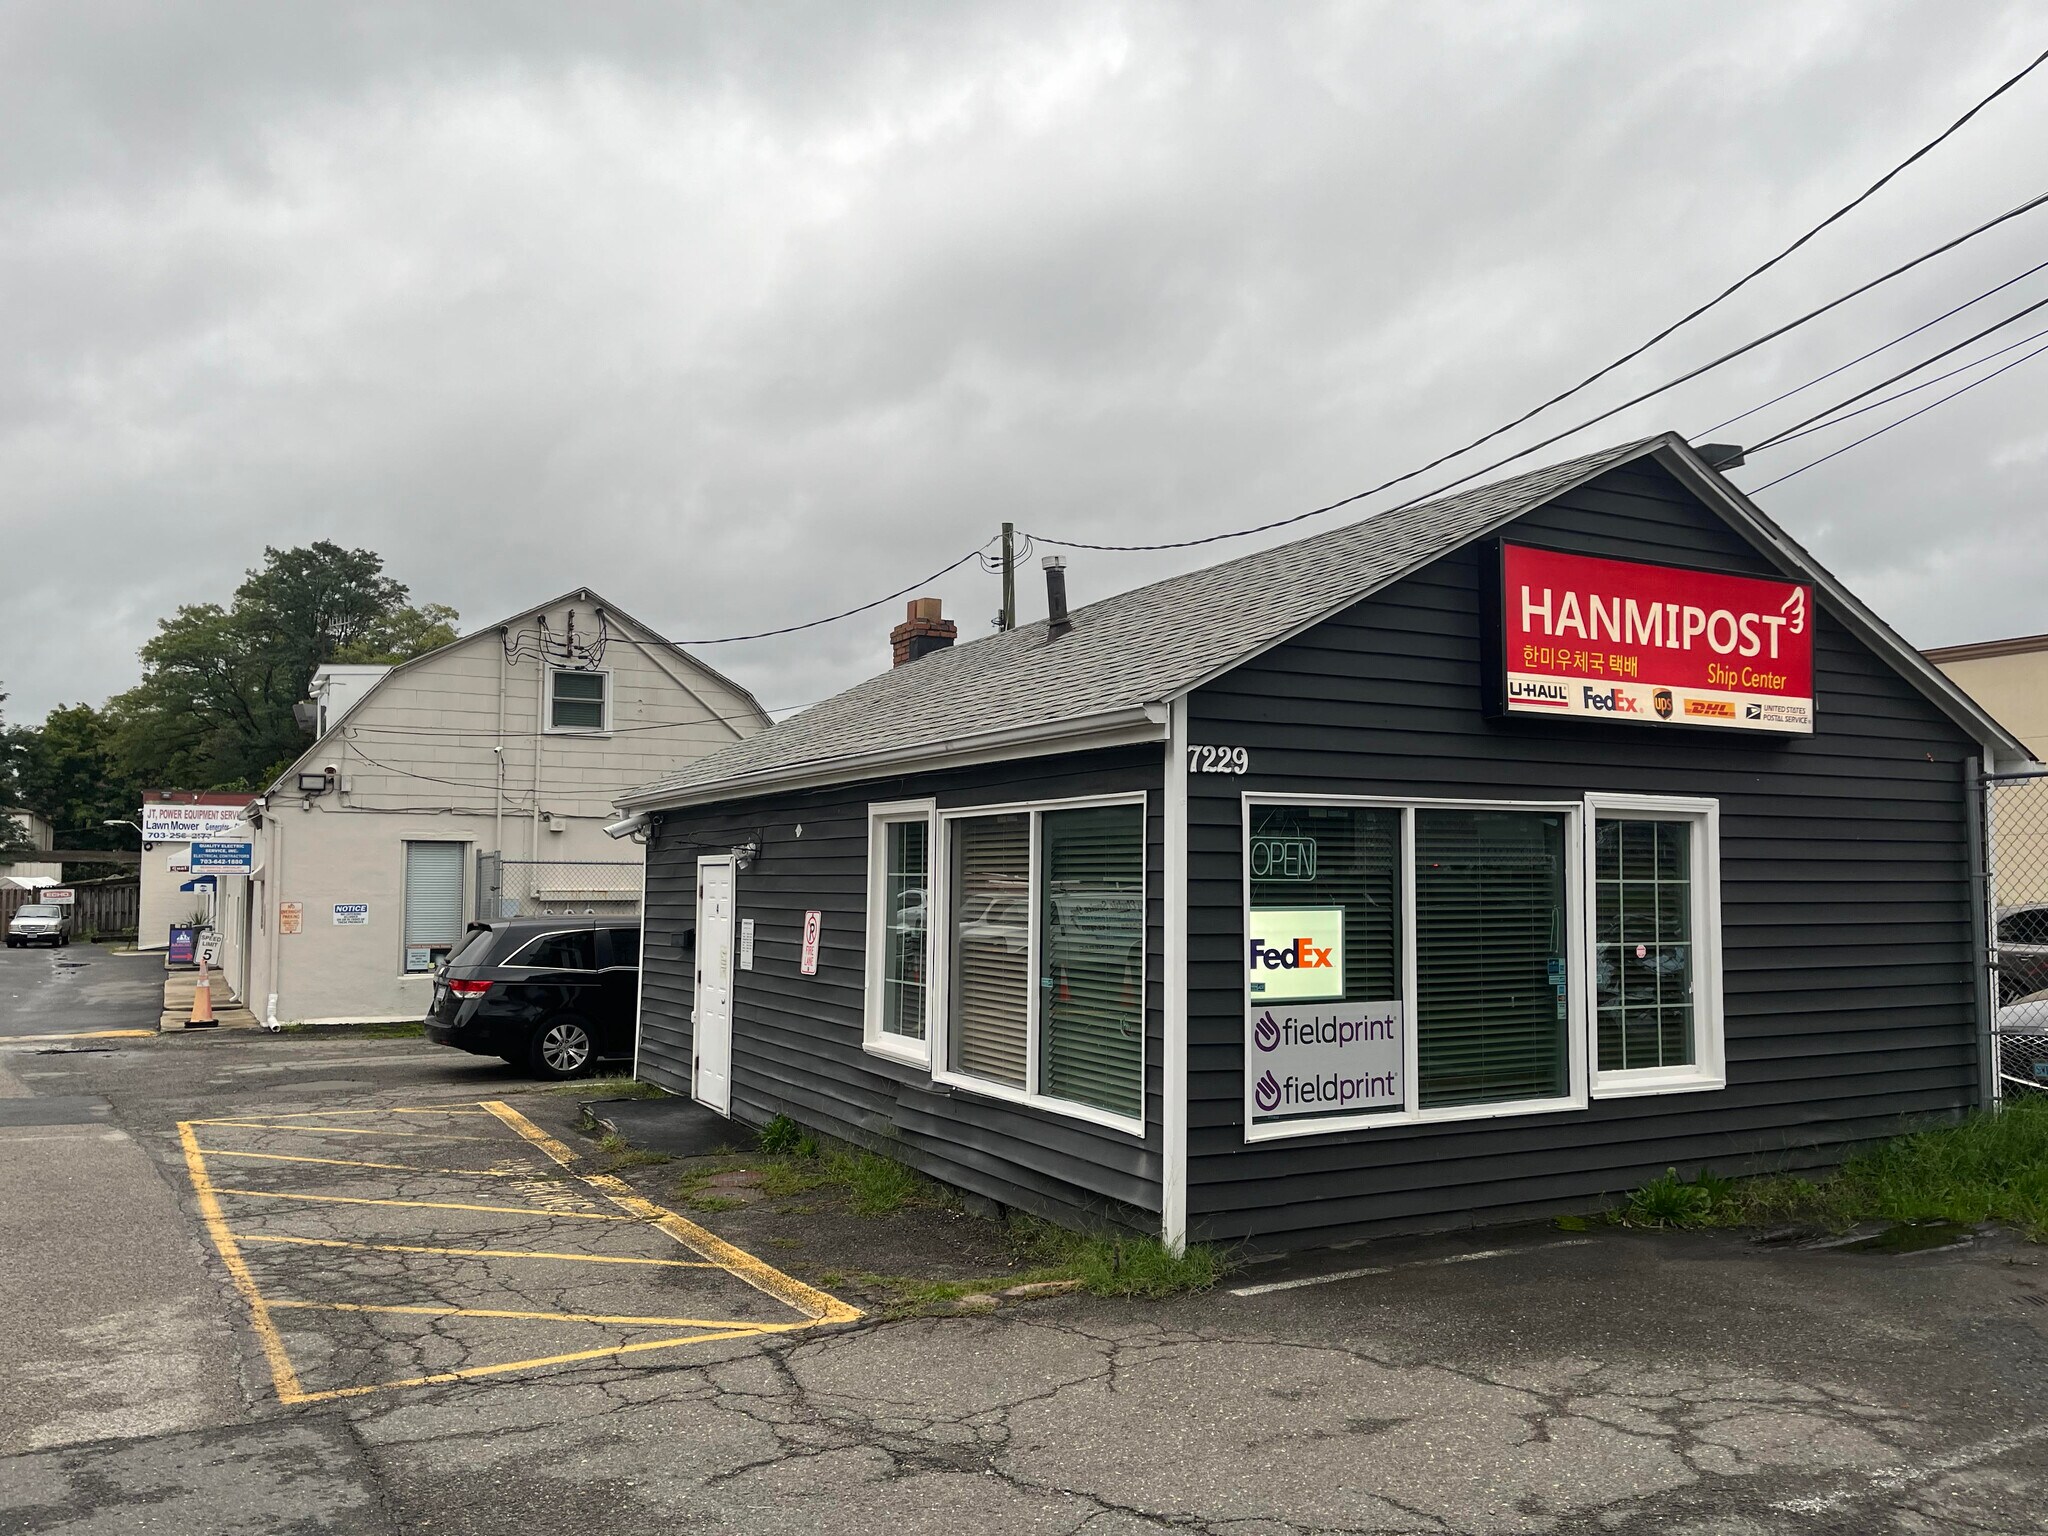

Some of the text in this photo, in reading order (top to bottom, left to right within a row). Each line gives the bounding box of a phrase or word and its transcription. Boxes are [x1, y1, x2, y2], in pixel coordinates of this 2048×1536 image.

[1521, 585, 1787, 659] HANMIPOST
[1523, 644, 1638, 678] 한미우체국 택배
[1707, 663, 1786, 690] Ship Center
[1510, 682, 1566, 700] U-HAUL
[1583, 686, 1638, 712] FedEx
[1655, 698, 1672, 714] ups
[1692, 702, 1728, 716] DHL
[1763, 714, 1808, 724] POSTAL SERVICE
[1764, 704, 1806, 714] UNITED STATES
[1188, 744, 1248, 774] 7229
[146, 820, 170, 830] Lawn
[171, 820, 200, 830] Mower
[160, 809, 182, 819] POWER
[184, 810, 219, 820] EQUIPMENT
[1251, 842, 1313, 876] OPEN
[203, 949, 212, 960] 5
[1250, 938, 1333, 970] FedEx
[1282, 1015, 1394, 1048] fieldprint
[1283, 1071, 1395, 1105] fieldprint
